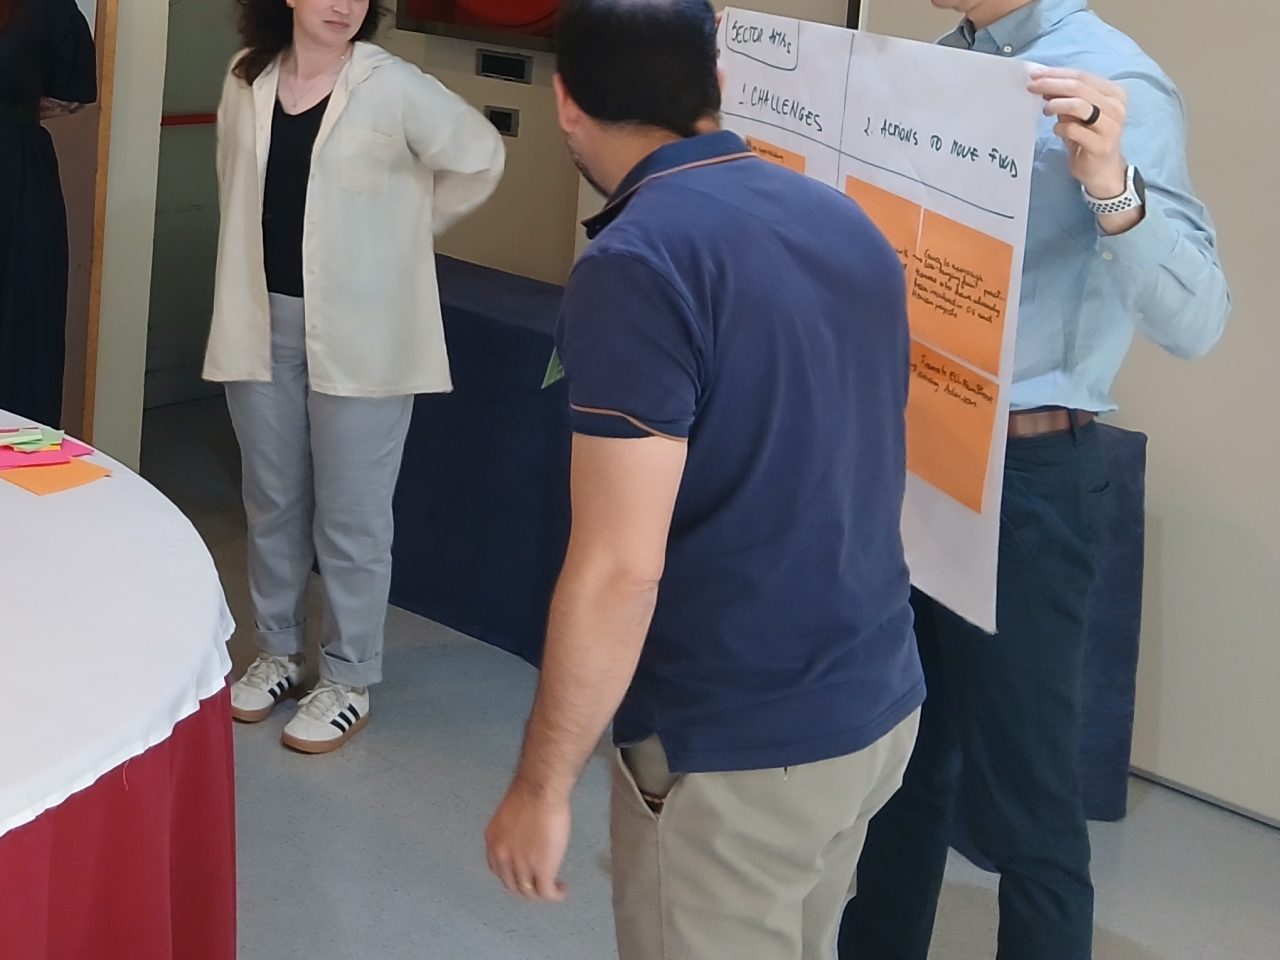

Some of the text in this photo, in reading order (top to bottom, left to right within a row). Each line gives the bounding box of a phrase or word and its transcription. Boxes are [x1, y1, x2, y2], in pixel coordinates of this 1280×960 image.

[731, 20, 764, 44] SECTOR
[750, 86, 823, 132] CHALLENGES
[880, 118, 919, 146] ACTIONS
[930, 135, 943, 152] TO
[950, 139, 980, 162] MOVE
[988, 148, 1018, 178] FWD
